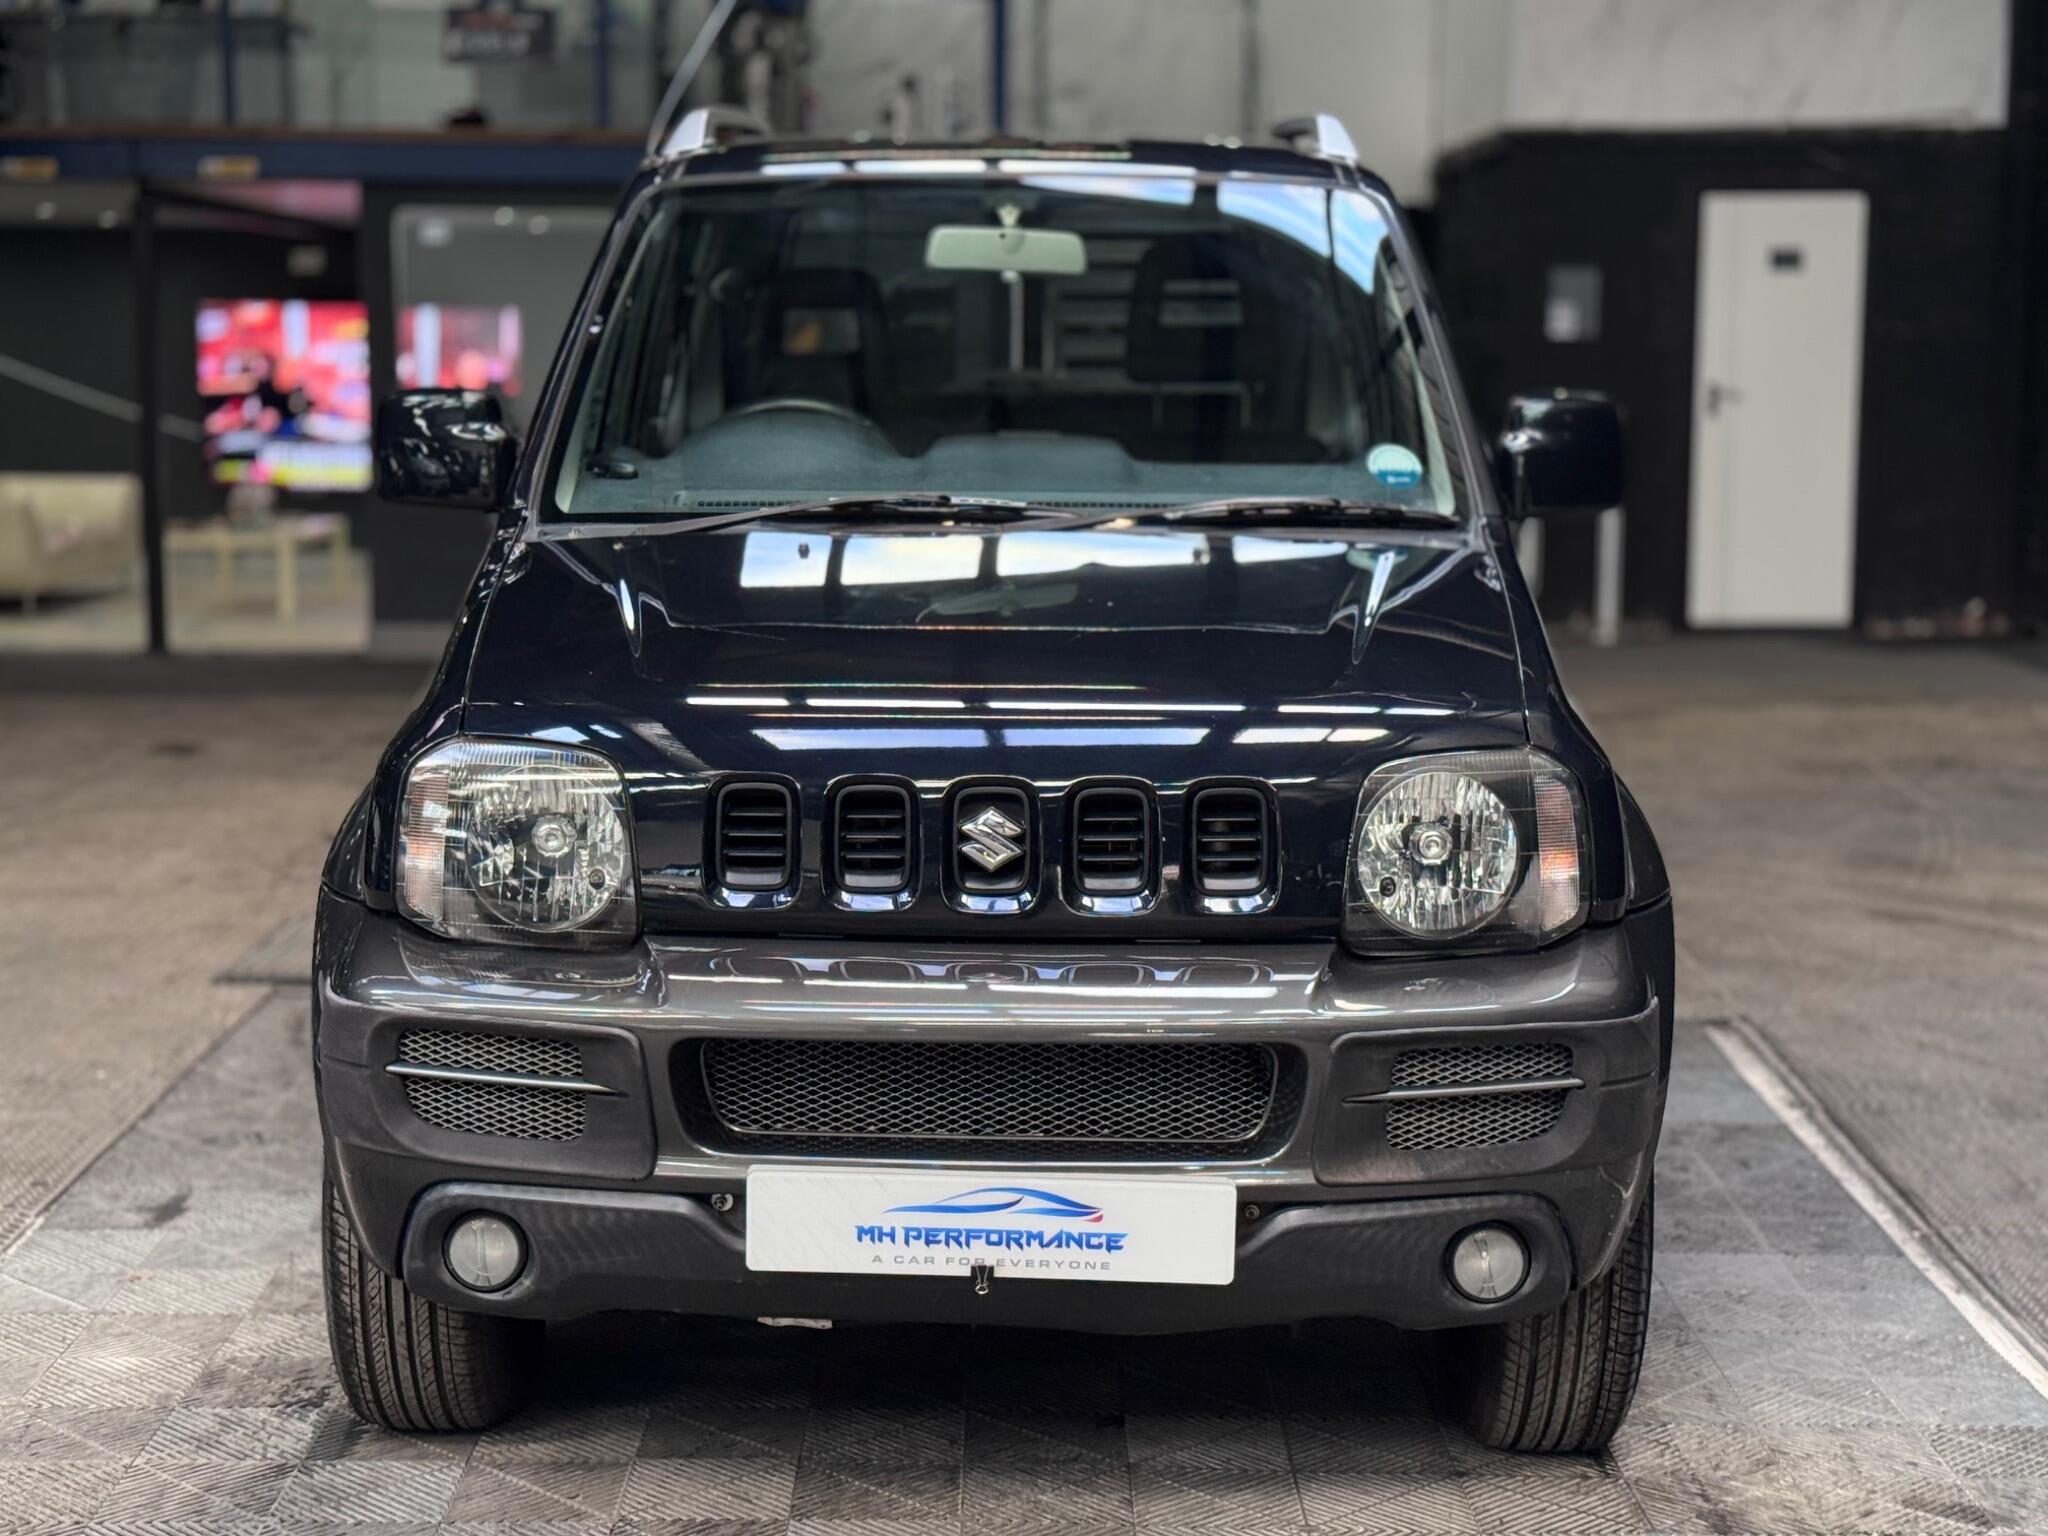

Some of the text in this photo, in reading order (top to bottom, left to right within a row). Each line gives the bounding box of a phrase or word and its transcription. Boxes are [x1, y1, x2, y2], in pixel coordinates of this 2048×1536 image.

[855, 1225, 1128, 1254] MH PERFORMANCE
[872, 1255, 1110, 1270] A CAR FOR EVERYONE
